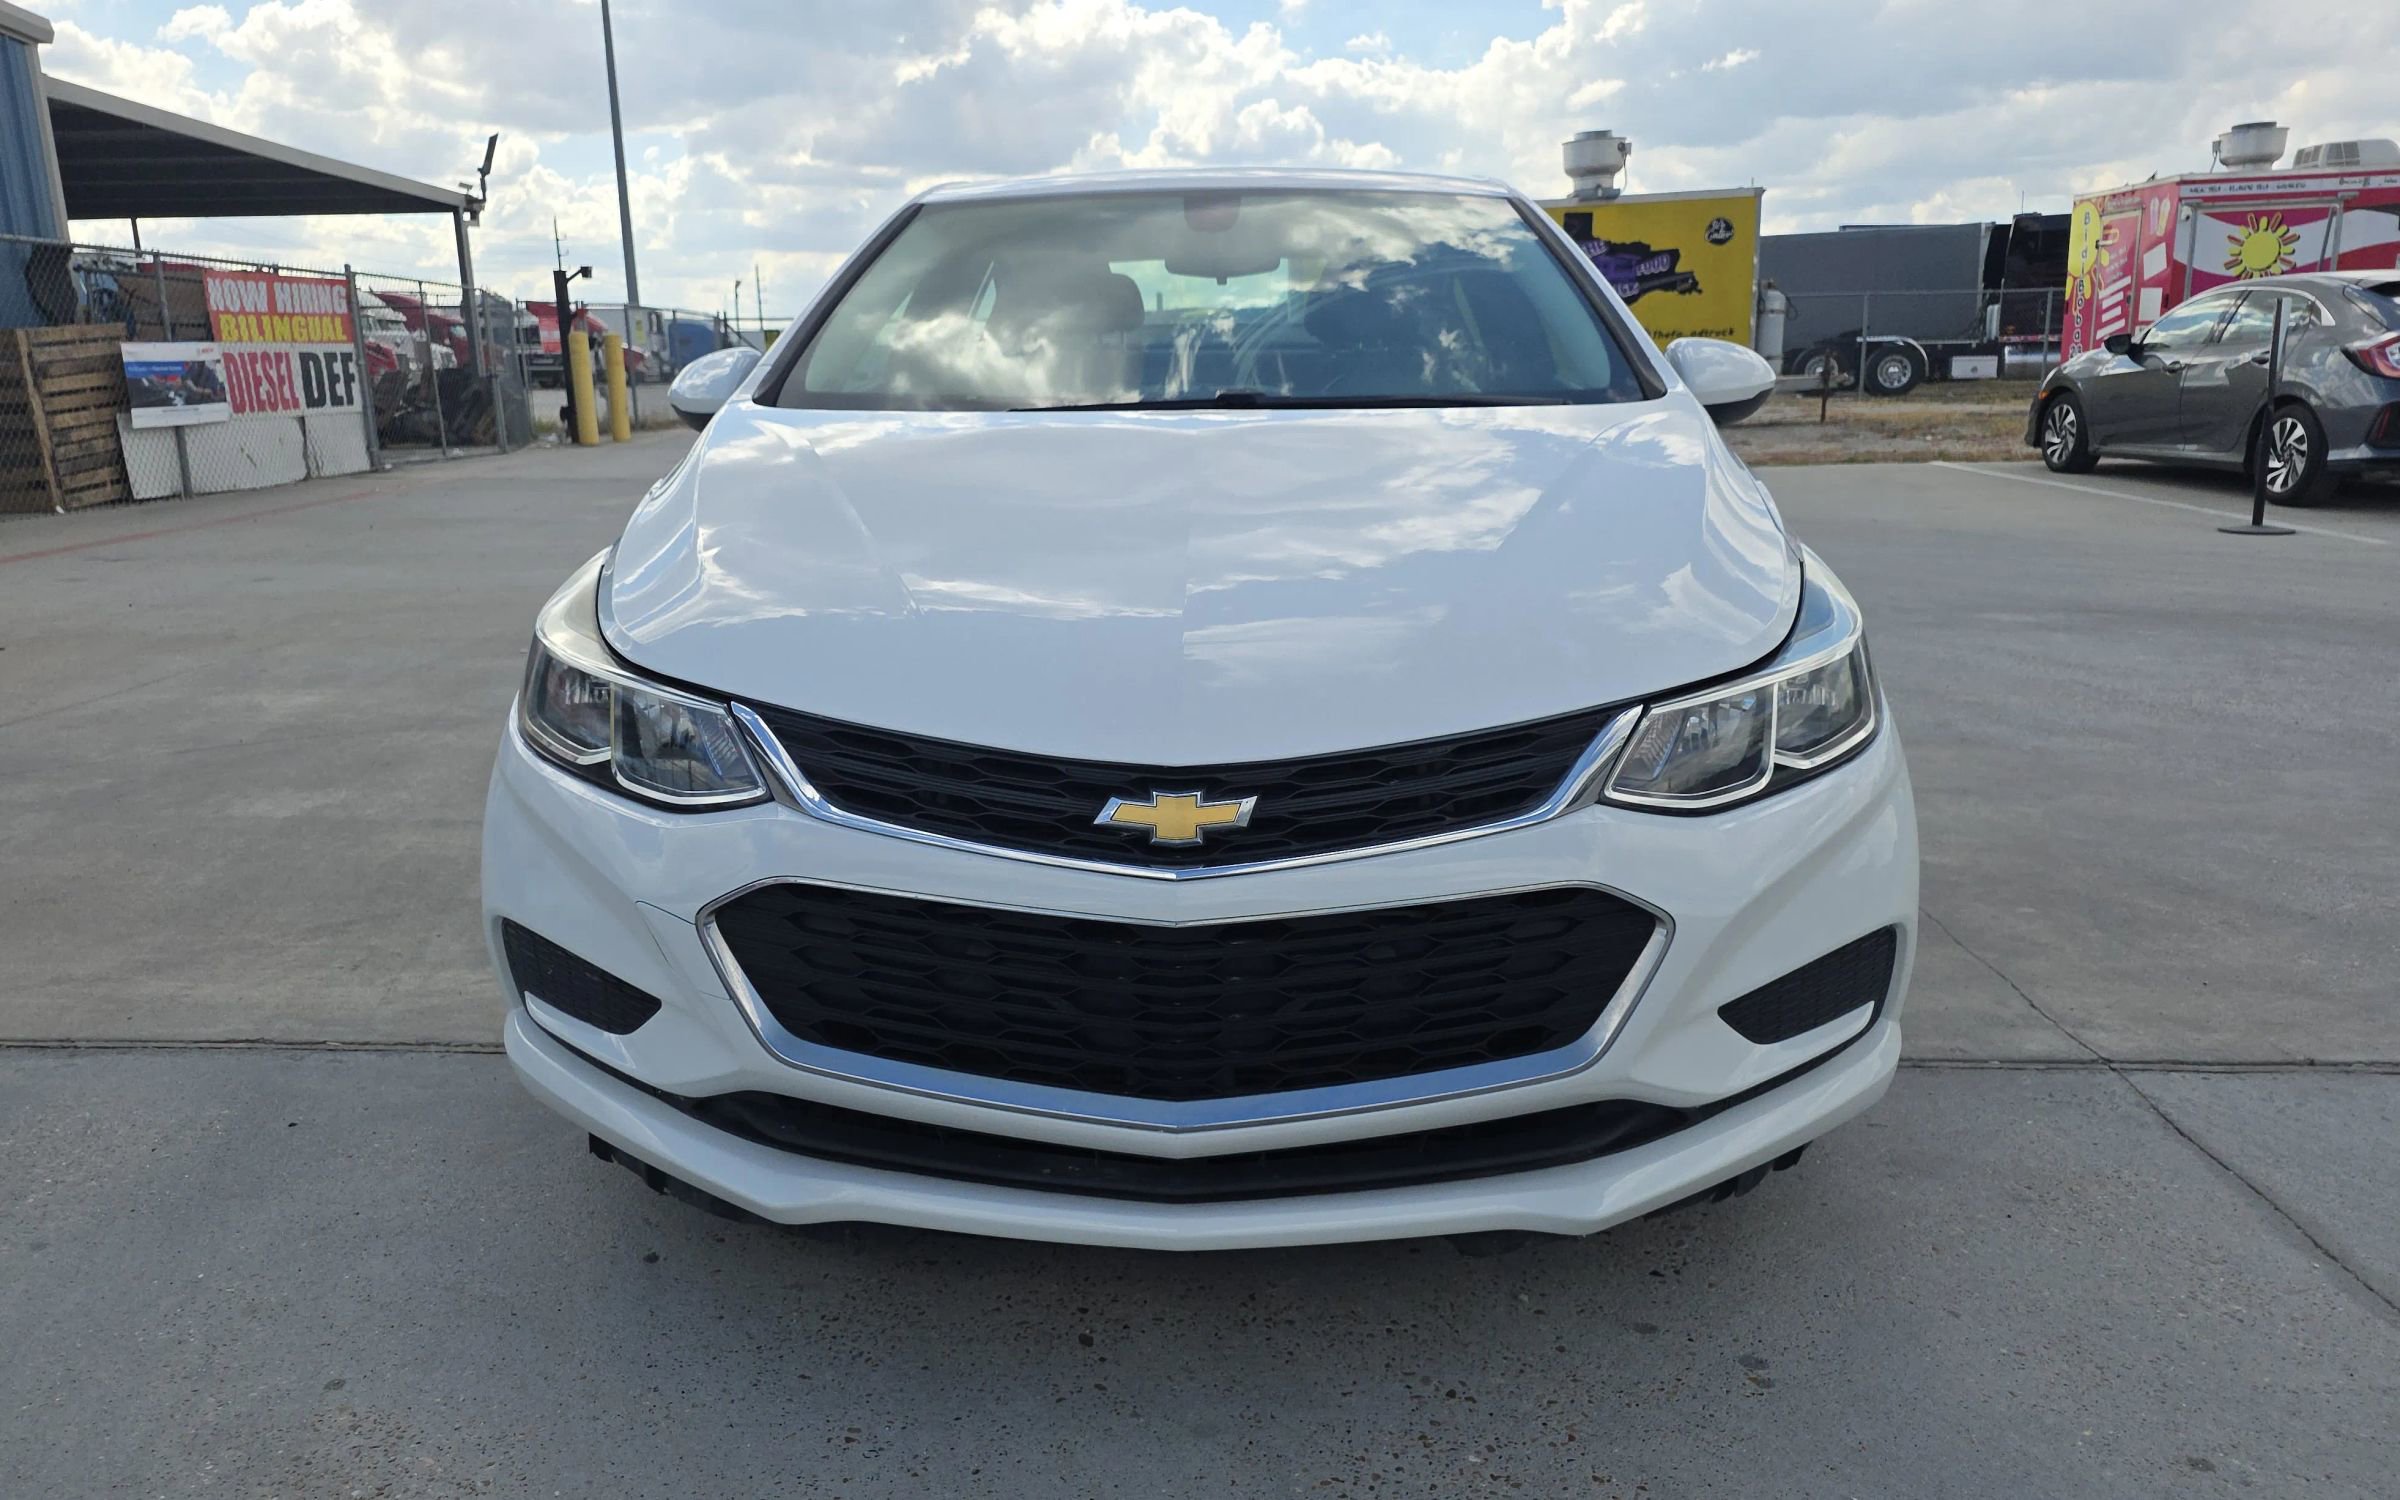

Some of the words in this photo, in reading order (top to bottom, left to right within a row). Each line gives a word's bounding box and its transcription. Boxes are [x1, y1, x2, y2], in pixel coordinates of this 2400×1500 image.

[207, 278, 268, 313] NOW
[273, 282, 347, 314] HIRING
[219, 314, 347, 343] BILINGUAL
[222, 352, 300, 414] DIESEL
[299, 352, 355, 409] DEF
